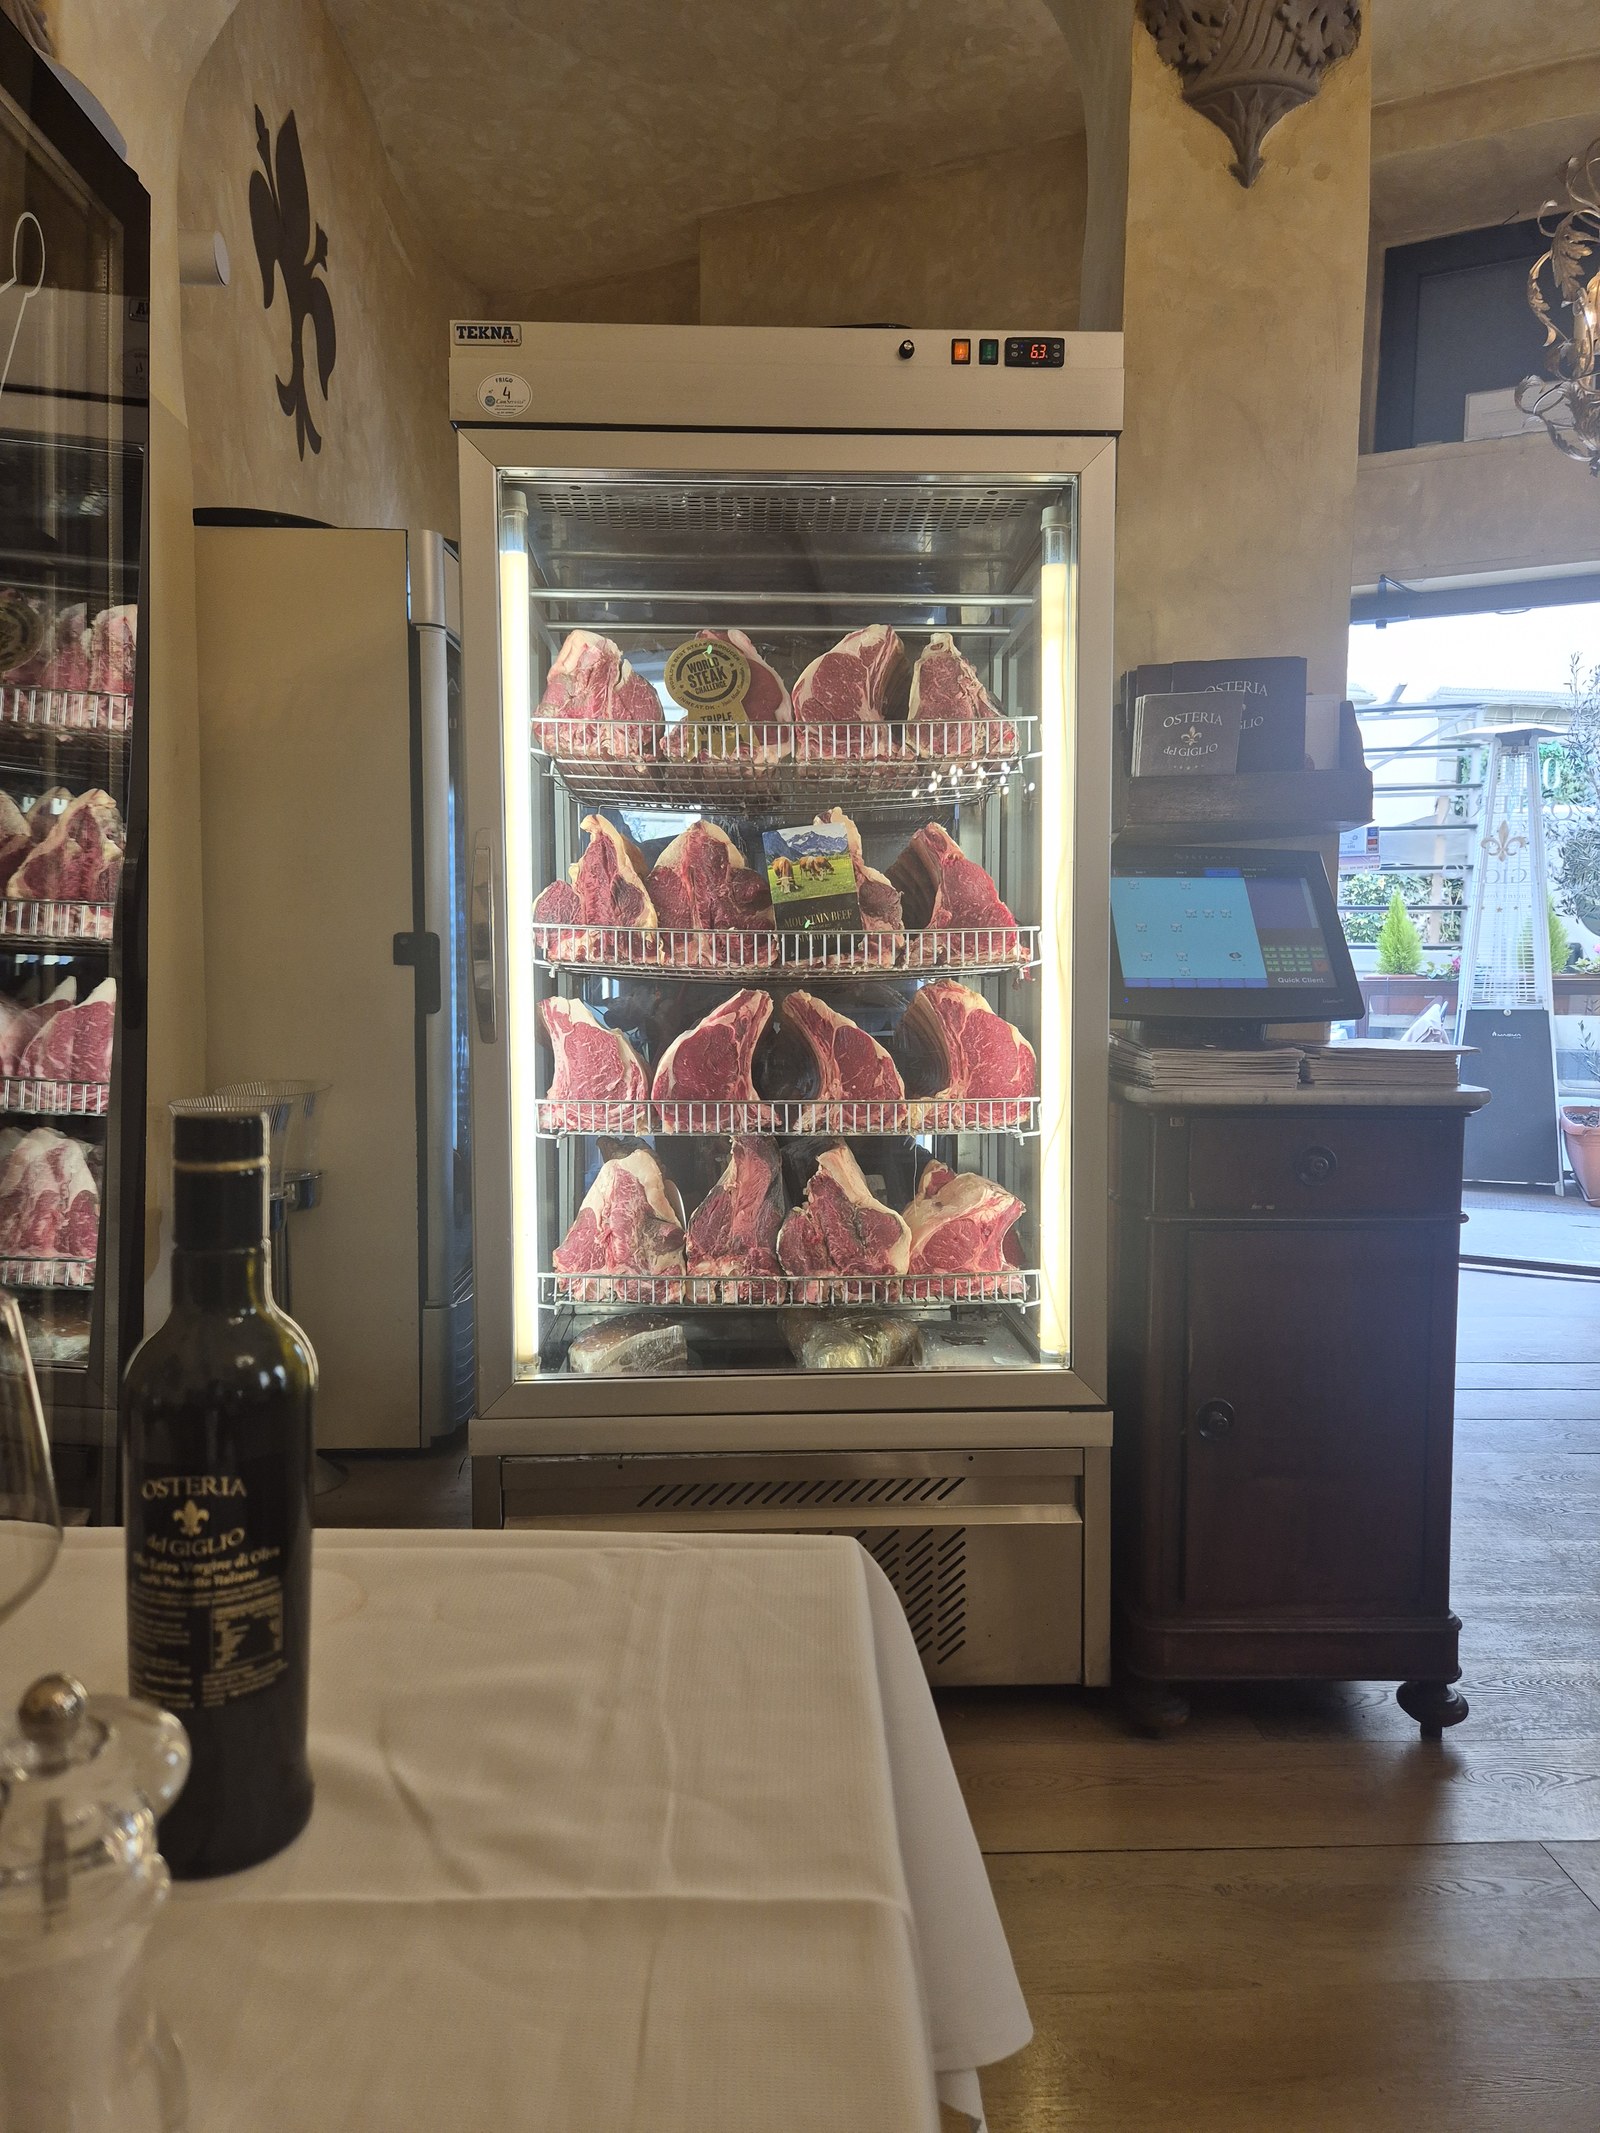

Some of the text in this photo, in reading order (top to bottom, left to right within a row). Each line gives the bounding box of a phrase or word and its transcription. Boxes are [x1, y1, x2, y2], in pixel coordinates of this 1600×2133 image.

[456, 326, 514, 340] TEKNA
[503, 386, 511, 400] 4
[687, 656, 720, 674] WORLD
[687, 666, 728, 689] STEAK
[695, 680, 728, 696] CHALLENGE
[1163, 711, 1223, 728] OSTERIA
[1163, 743, 1218, 757] del GIGLIO
[142, 1475, 248, 1500] OSTERIA
[147, 1527, 246, 1557] del GIGLIO
